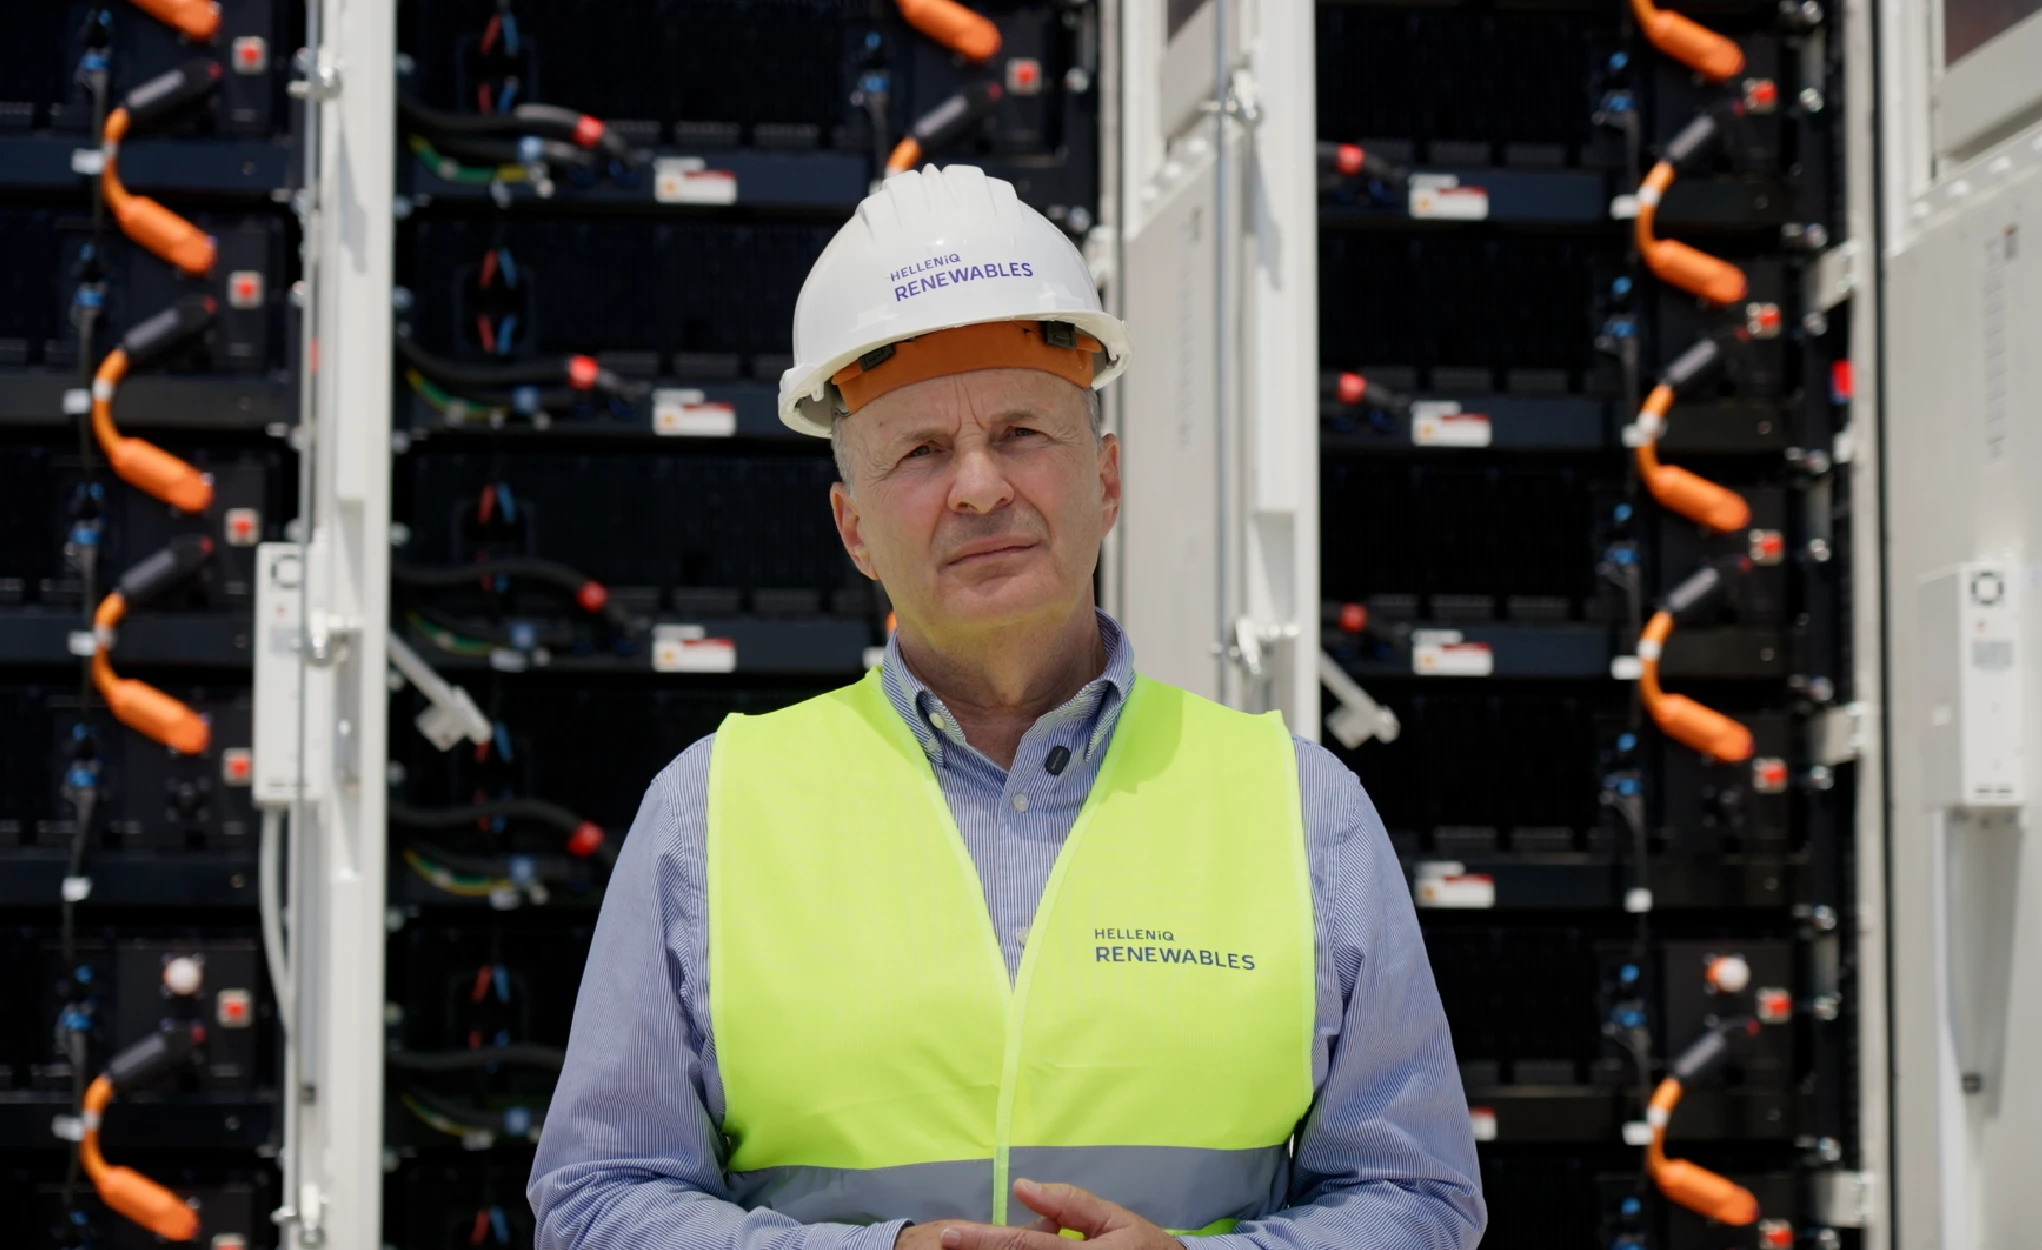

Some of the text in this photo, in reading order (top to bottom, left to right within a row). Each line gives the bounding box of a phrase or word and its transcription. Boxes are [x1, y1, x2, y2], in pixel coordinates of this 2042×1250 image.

[890, 253, 961, 282] HELLENiQ
[894, 262, 1034, 302] RENEWABLES
[1094, 928, 1175, 941] HELLENiQ
[1096, 946, 1256, 970] RENEWABLES
